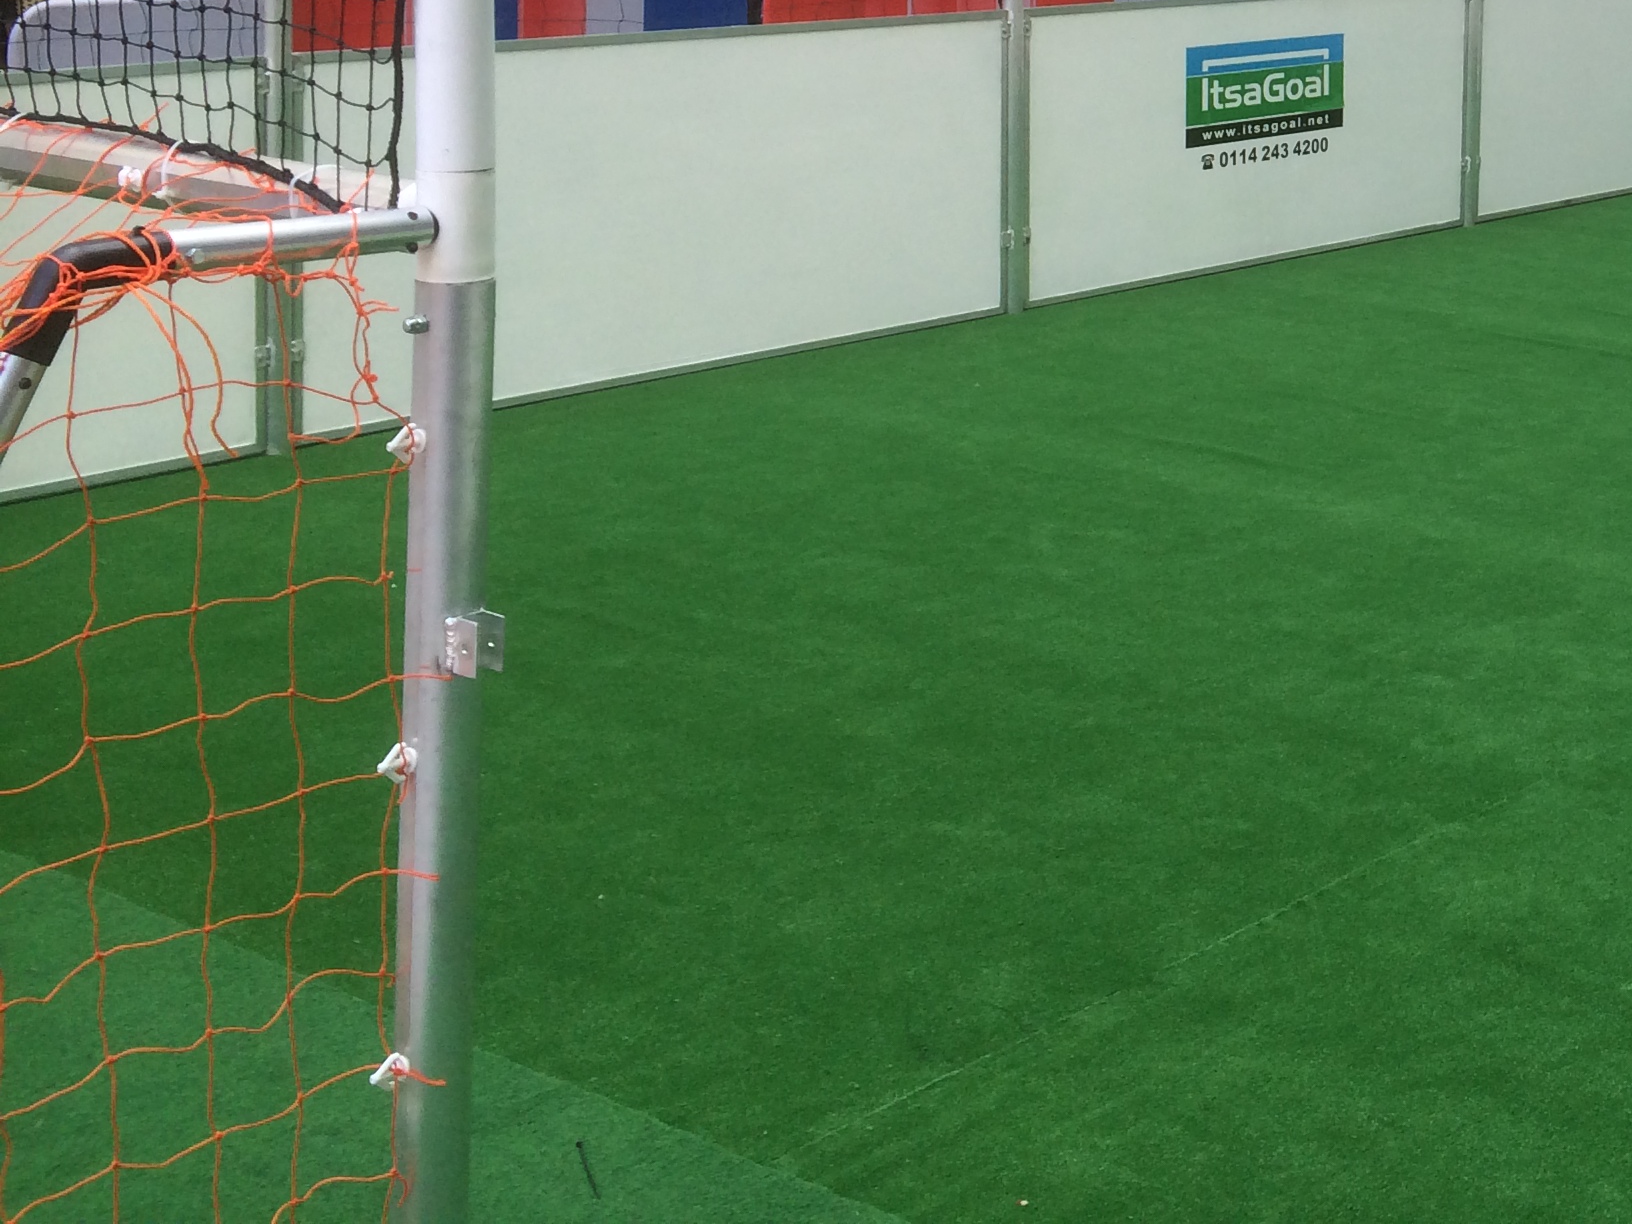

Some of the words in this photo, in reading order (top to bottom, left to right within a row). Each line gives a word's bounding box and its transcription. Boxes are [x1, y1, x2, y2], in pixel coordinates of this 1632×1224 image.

[1201, 63, 1330, 112] ItsaGoal
[1201, 113, 1330, 141] www.itsagoal.net
[1219, 147, 1258, 168] 0114
[1261, 142, 1289, 162] 243
[1292, 136, 1329, 156] 4200
